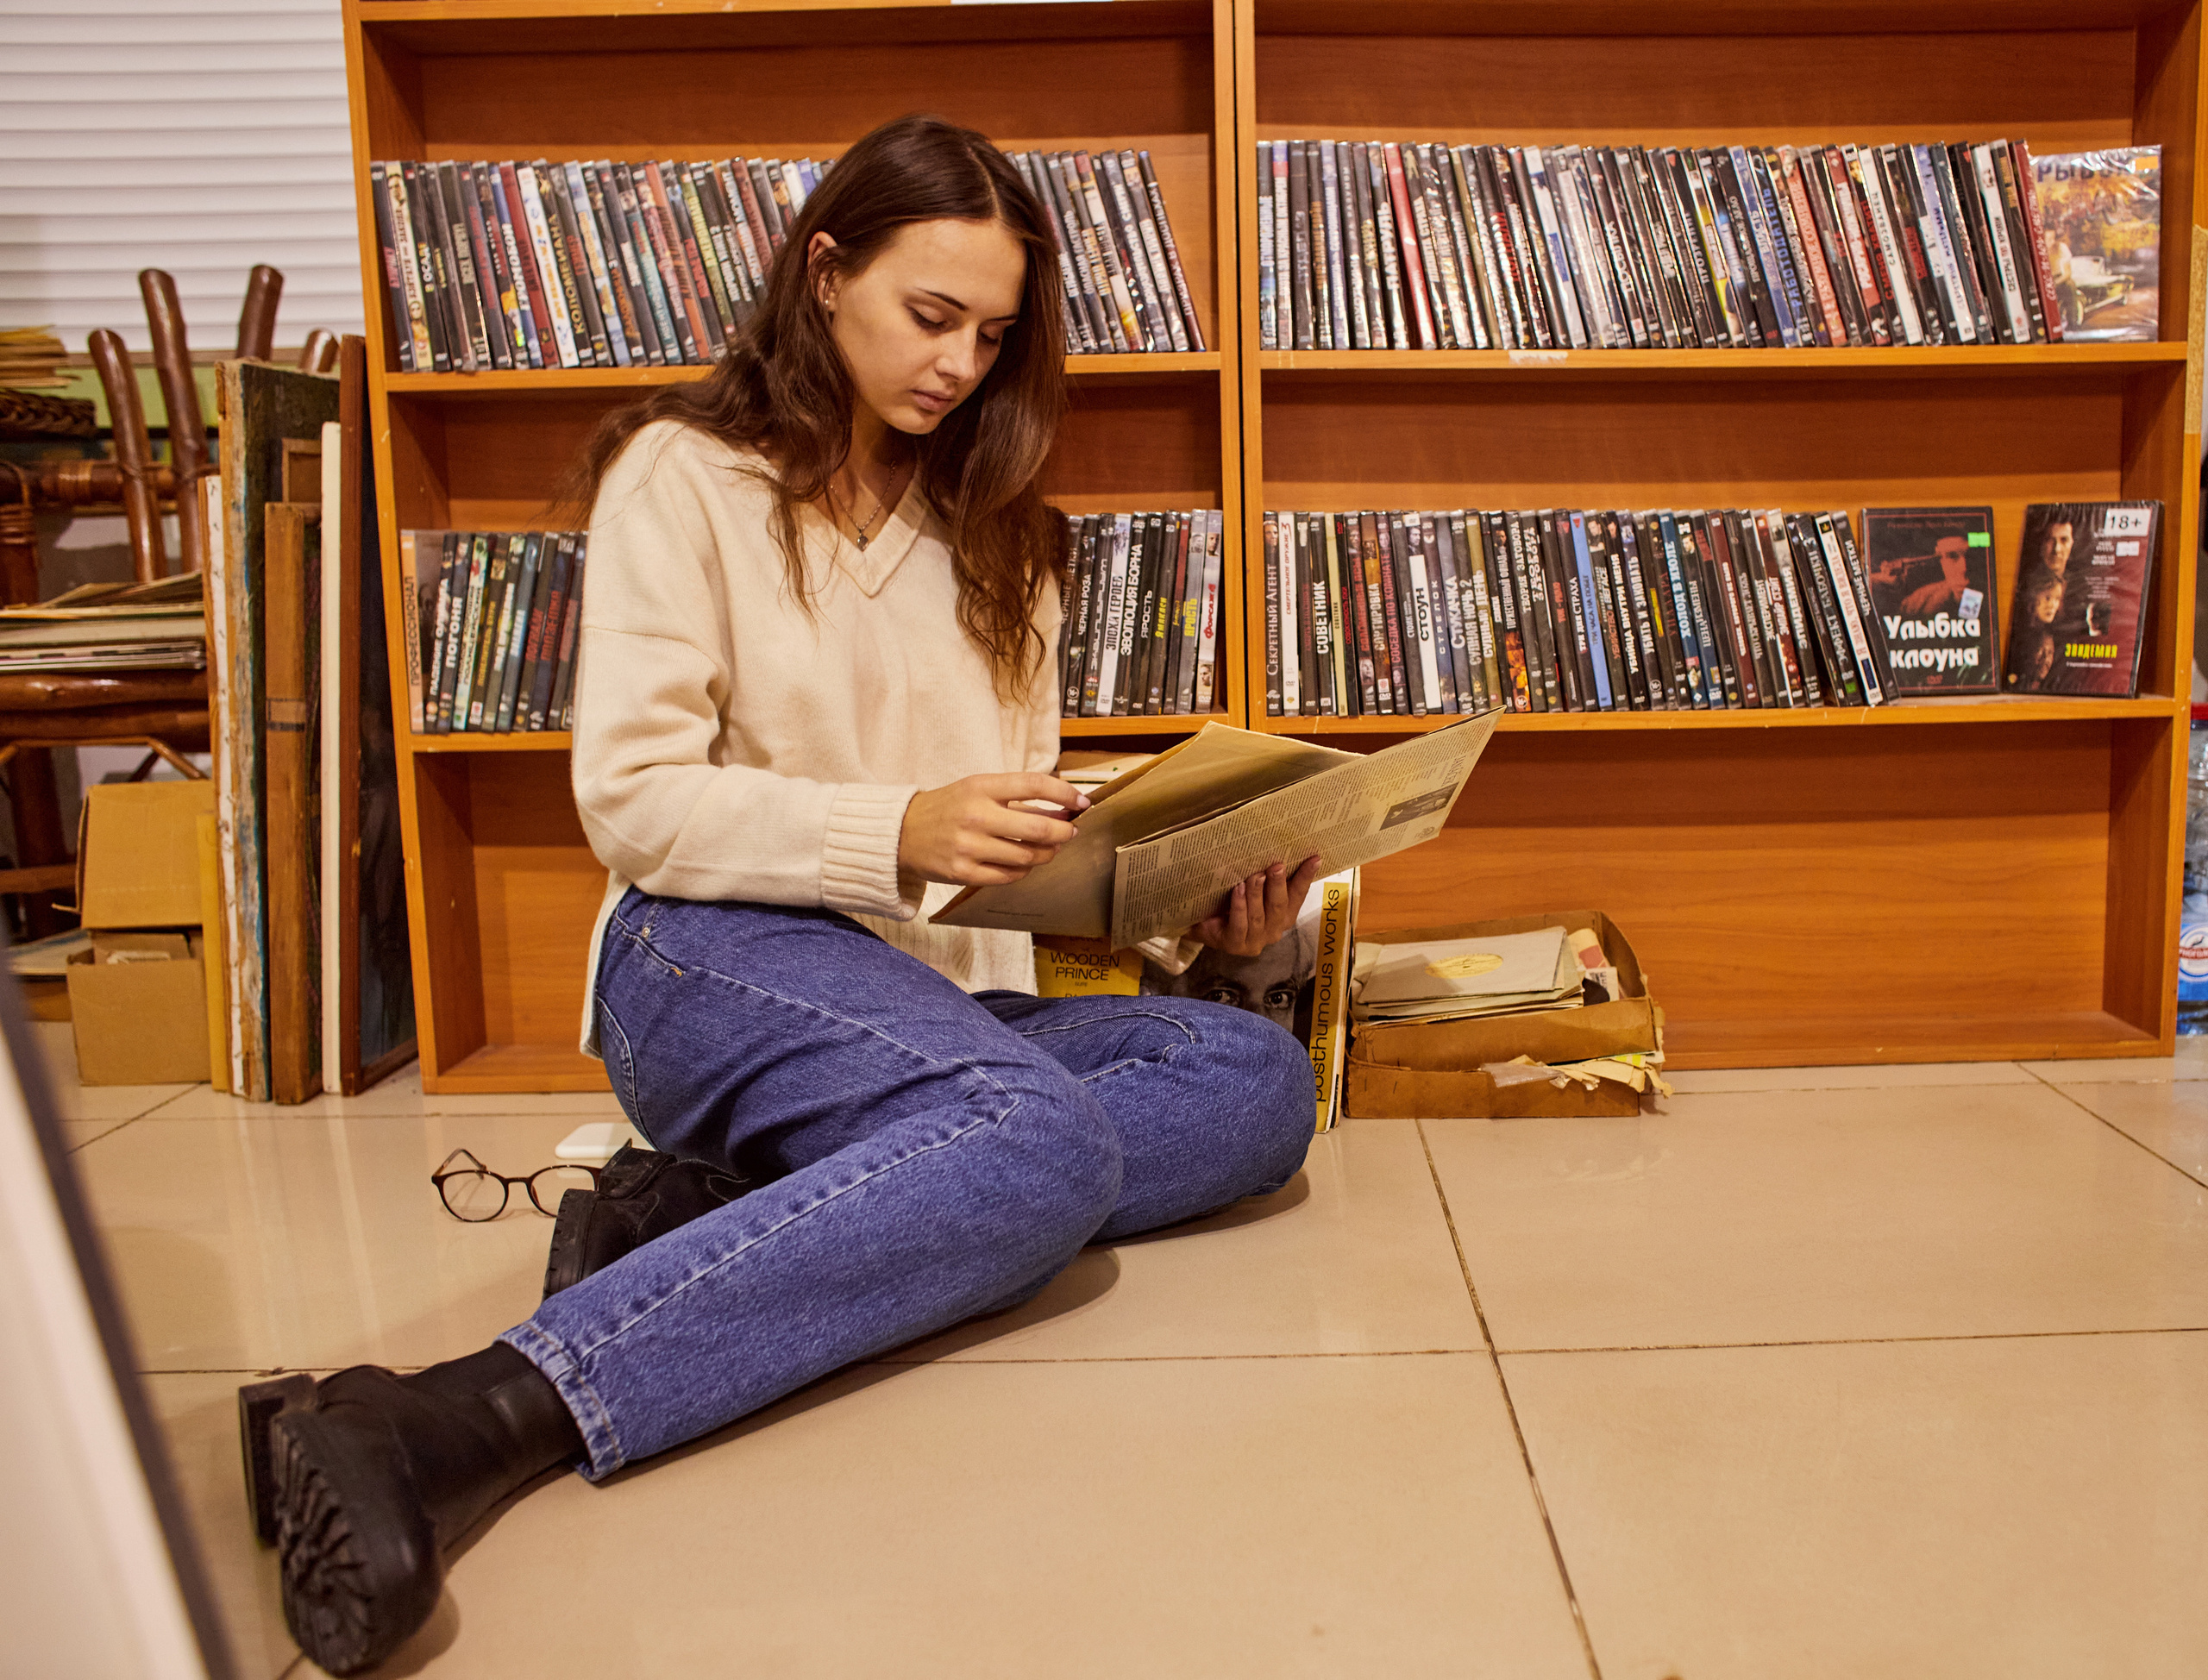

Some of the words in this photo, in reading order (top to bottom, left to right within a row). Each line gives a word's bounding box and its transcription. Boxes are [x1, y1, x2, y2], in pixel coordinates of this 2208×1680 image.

[721, 172, 743, 223] МОМЕНТ
[1377, 202, 1399, 290] ПАТРУЛЬ
[1751, 210, 1770, 254] ВЛАСТЬ
[1763, 188, 1802, 308] РАБОТОДАТЕЛЬ
[1872, 191, 1896, 266] САМОЗВАНЕЦ
[501, 223, 530, 310] ГРОМОБОЙ
[548, 213, 585, 335] КОЛОМБИАНА
[1605, 221, 1634, 294] ПОСЫЛКА
[1875, 253, 1891, 287] МЕНЯ
[1173, 260, 1195, 316] ПРИЗРАК
[1885, 291, 1894, 300] С
[1803, 536, 1817, 547] 3
[2109, 515, 2142, 530] 18+
[1127, 543, 1143, 586] БОРНА
[1497, 555, 1509, 578] ФИНАЛ
[1510, 521, 1525, 571] ЗАГОВОРА
[1524, 528, 1539, 602] ТЕОРИЯ
[1529, 526, 1545, 601] ЗАГОВОРА
[1664, 541, 1680, 580] ИЮЛЕ
[1845, 539, 1862, 575] МЕТКИ
[1082, 574, 1092, 599] РОЗА
[1381, 553, 1394, 600] КОМНАТЕ
[1459, 579, 1473, 587] 2
[1472, 569, 1489, 606] ДЕНЬ
[1599, 567, 1612, 603] ВЕГАСЕ
[1610, 553, 1624, 585] МЕНЯ
[1628, 555, 1647, 609] ЗАКОПАТЬ
[1672, 582, 1682, 592] В
[1768, 576, 1783, 601] СТЭЙТ
[1809, 550, 1832, 608] БАБОЧКИ
[1832, 555, 1847, 589] ВИДЕЛА
[1090, 558, 1108, 670] ЭКВИЛИБРИУМ
[1141, 590, 1153, 638] ЯРОСТЬ
[1386, 602, 1396, 617] ПО
[1415, 587, 1429, 642] СТОУН
[1461, 589, 1477, 619] НОЧЬ
[1500, 578, 1516, 630] ТОРЖЕСТВЕННЫЙ
[1519, 574, 1532, 613] ТЕОРИЯ
[1569, 577, 1582, 615] СТРАХА
[1586, 598, 1593, 609] НА
[1616, 586, 1631, 629] ВНУТРИ
[1675, 592, 1691, 638] ХОЛОД
[1689, 580, 1703, 621] ИЗМЕНЫ
[1754, 579, 1776, 642] ЭКСПЕРИМЕНТ
[1781, 567, 1808, 649] ЭПИДЕМИЯ
[1845, 600, 1856, 616] ЧТО
[1854, 574, 1871, 617] ЧЕРНЫЕ
[404, 575, 419, 686] ПРОФЕССИОНАЛ
[445, 597, 463, 668] ПОГОНЯ
[1077, 599, 1088, 636] ЧЕРНАЯ
[1106, 617, 1119, 651] ЭПОХА
[1120, 586, 1139, 655] ЭВОЛЮЦИЯ
[1183, 599, 1198, 636] ЯРОСТЬ
[1313, 580, 1329, 654] СОВЕТНИК
[1368, 582, 1386, 651] СОРТИРОВКА
[1405, 615, 1414, 638] СТОИК
[1431, 580, 1446, 655] СТРЕЛОК
[1477, 609, 1494, 658] СУДНЫЙ
[1607, 610, 1621, 660] УБИЙСТВО
[1642, 621, 1655, 655] УБИТЬ
[1699, 620, 1711, 647] ЦЕНА
[1744, 599, 1760, 640] СКРЫВАЕТ
[1884, 612, 1981, 640] Улыбка
[1387, 617, 1402, 663] СОСЕДКА
[1465, 621, 1482, 666] СУДНАЯ
[1622, 629, 1639, 674] УБИЙЦА
[1750, 641, 1763, 659] ЧТО
[1829, 613, 1847, 666] ЭФФЕКТ
[1856, 647, 1866, 655] Я
[1890, 648, 1979, 672] клоуна
[2065, 643, 2117, 659] ЭПИДЕМИЯ
[1051, 952, 1120, 967] WOODEN
[1056, 967, 1109, 981] PRINCE
[1311, 962, 1334, 1102] posthumous
[1323, 888, 1340, 956] works
